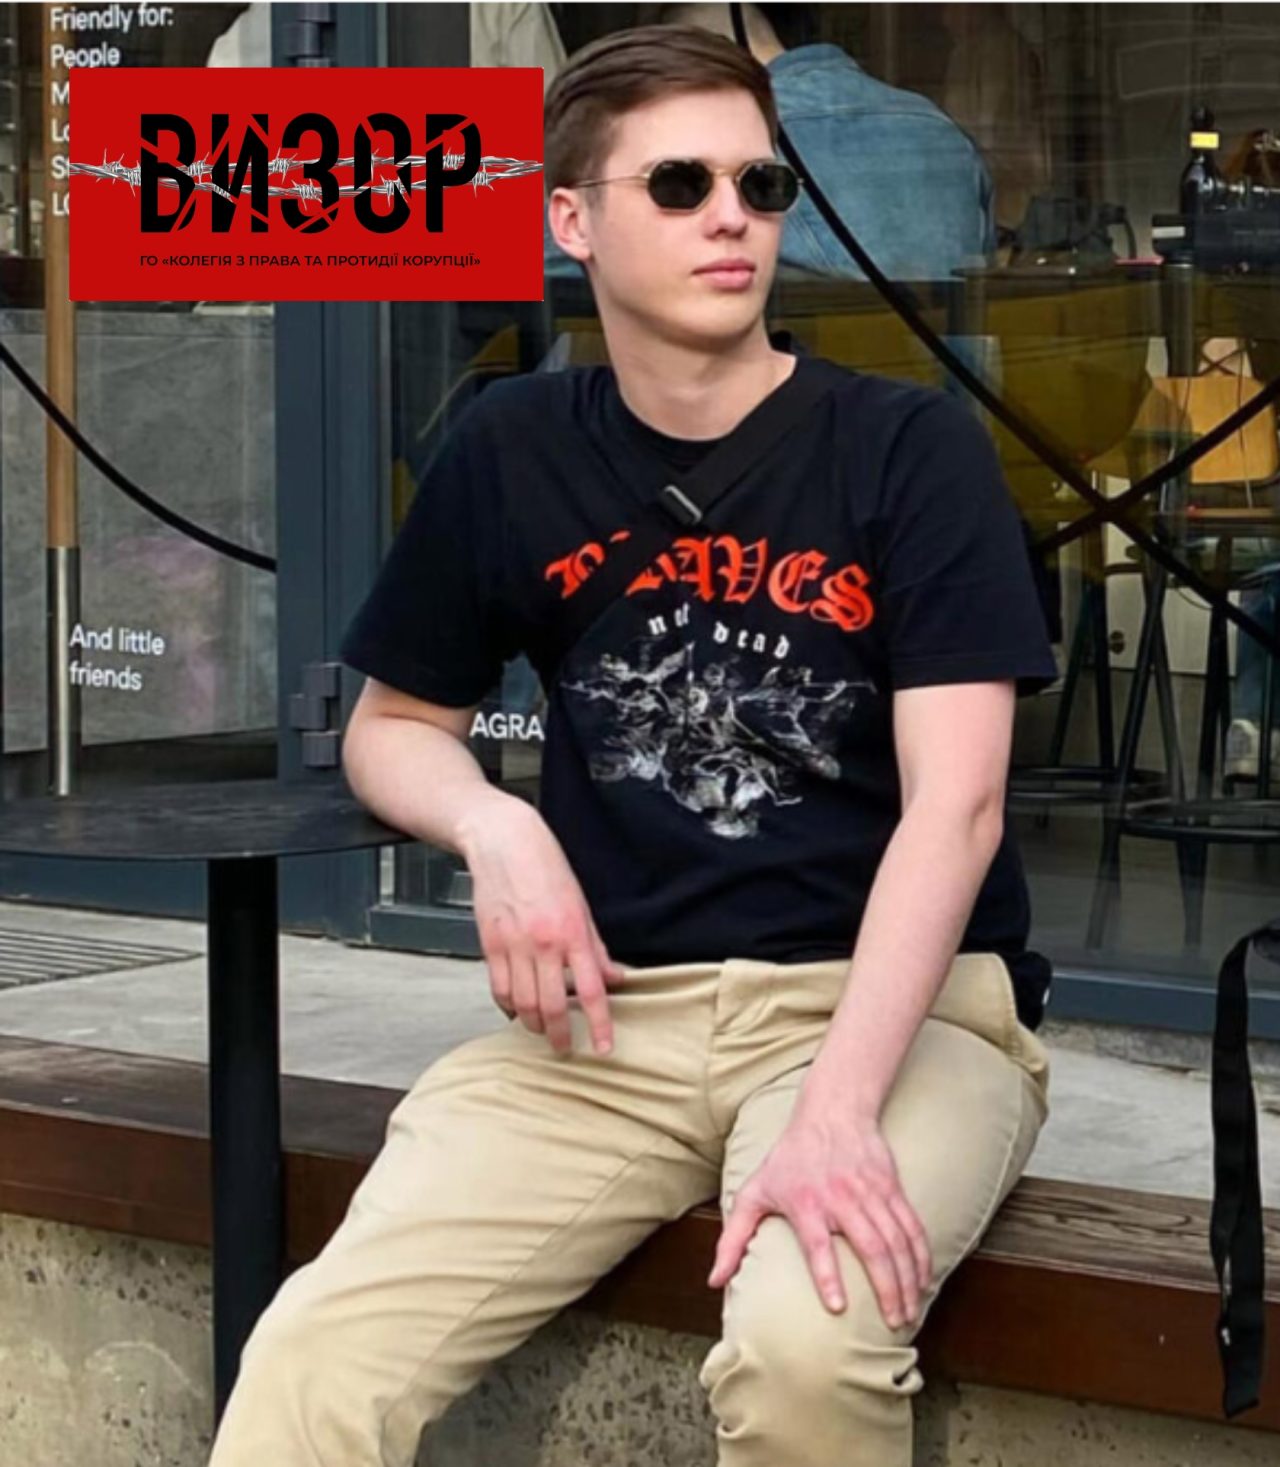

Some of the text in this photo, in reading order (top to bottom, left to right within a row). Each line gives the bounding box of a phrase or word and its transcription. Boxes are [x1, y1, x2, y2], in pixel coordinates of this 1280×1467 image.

[50, 1, 174, 33] Friendly for:
[50, 41, 121, 69] People
[69, 623, 165, 655] And little
[713, 620, 790, 659] dead
[69, 660, 142, 691] friends
